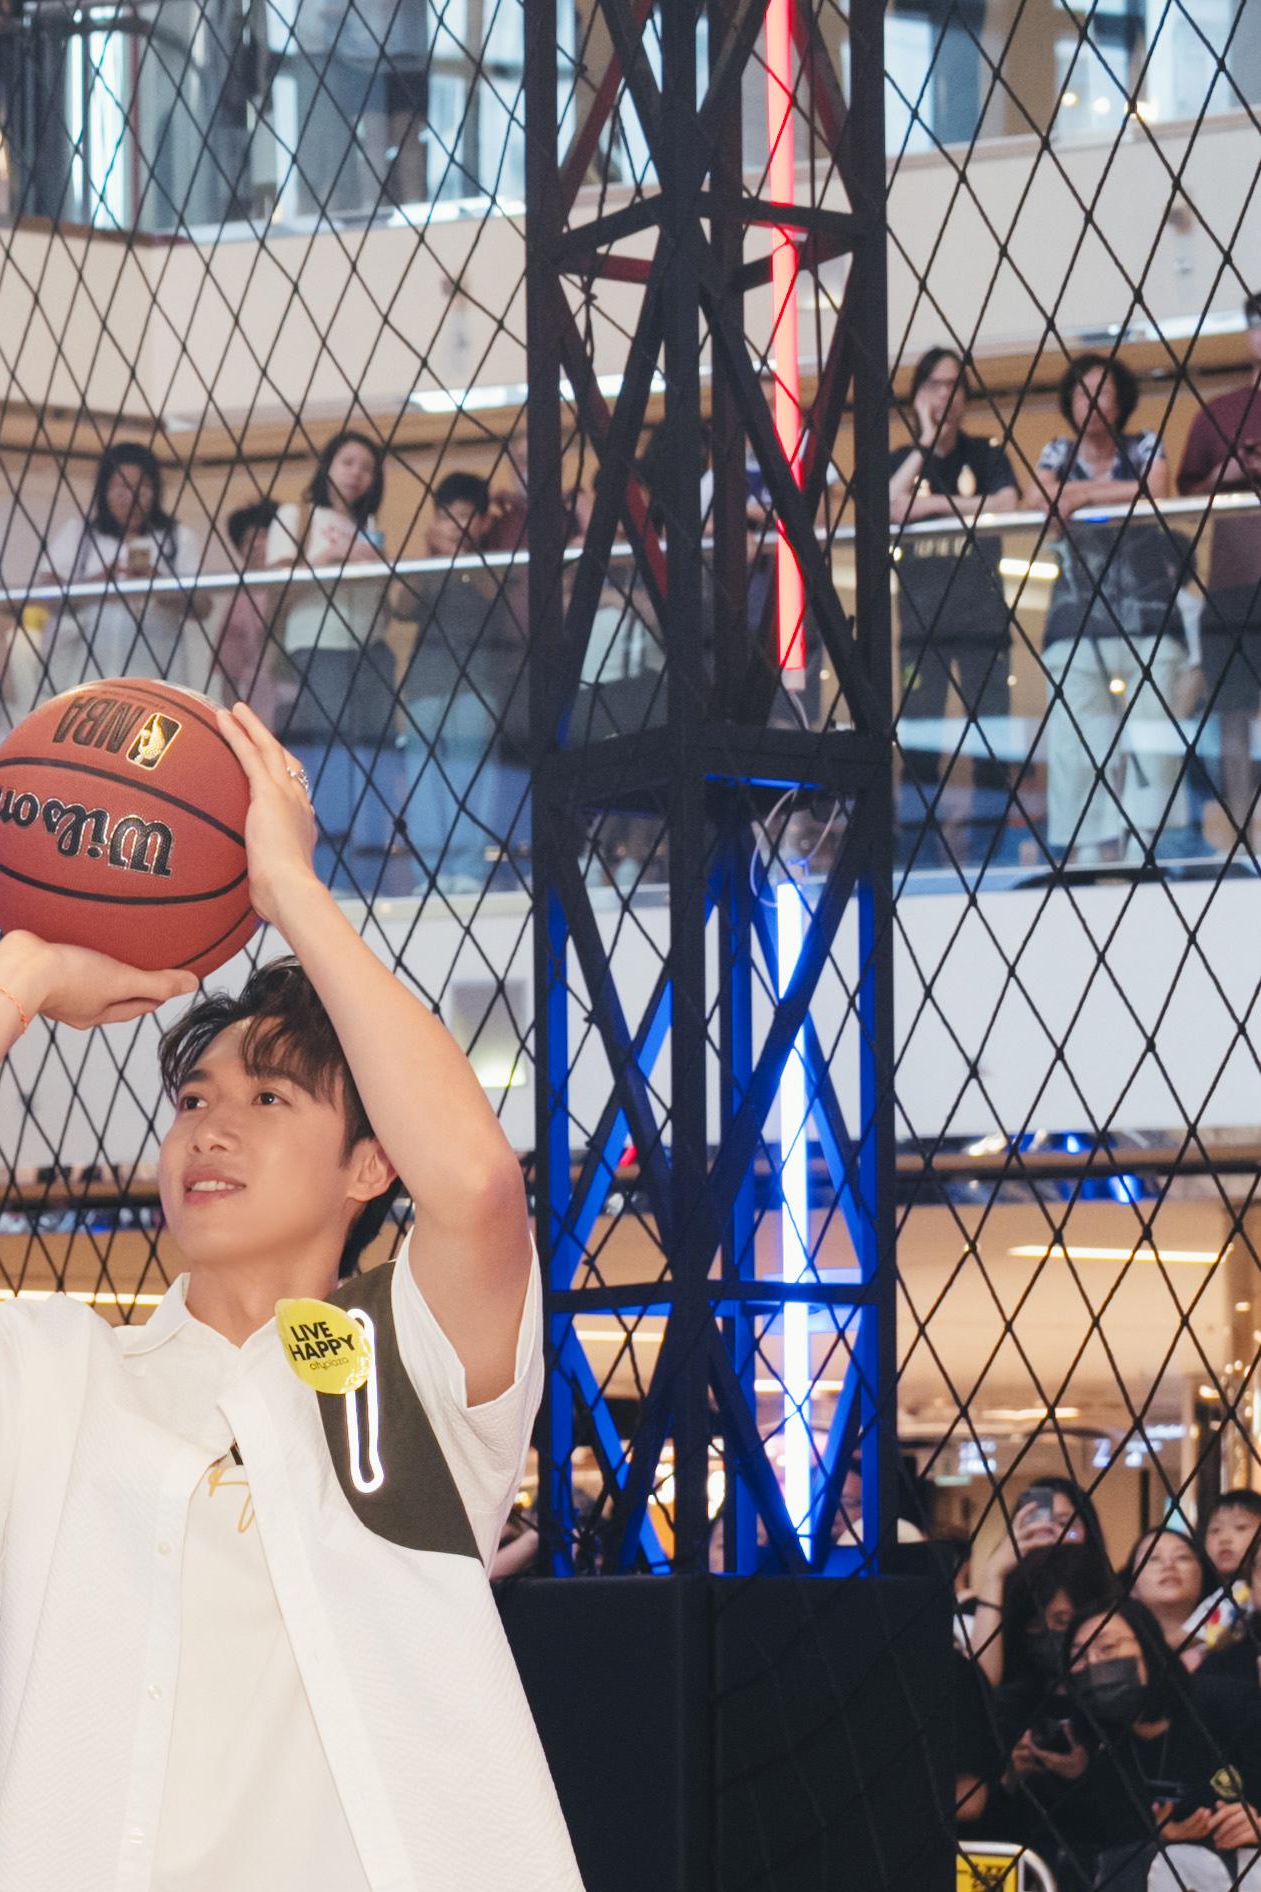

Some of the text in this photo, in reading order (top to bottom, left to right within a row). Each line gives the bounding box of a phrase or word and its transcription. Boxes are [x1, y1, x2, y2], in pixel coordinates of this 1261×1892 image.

[52, 696, 146, 754] NBA
[290, 1321, 333, 1342] LIVE
[288, 1333, 355, 1362] HAPPY
